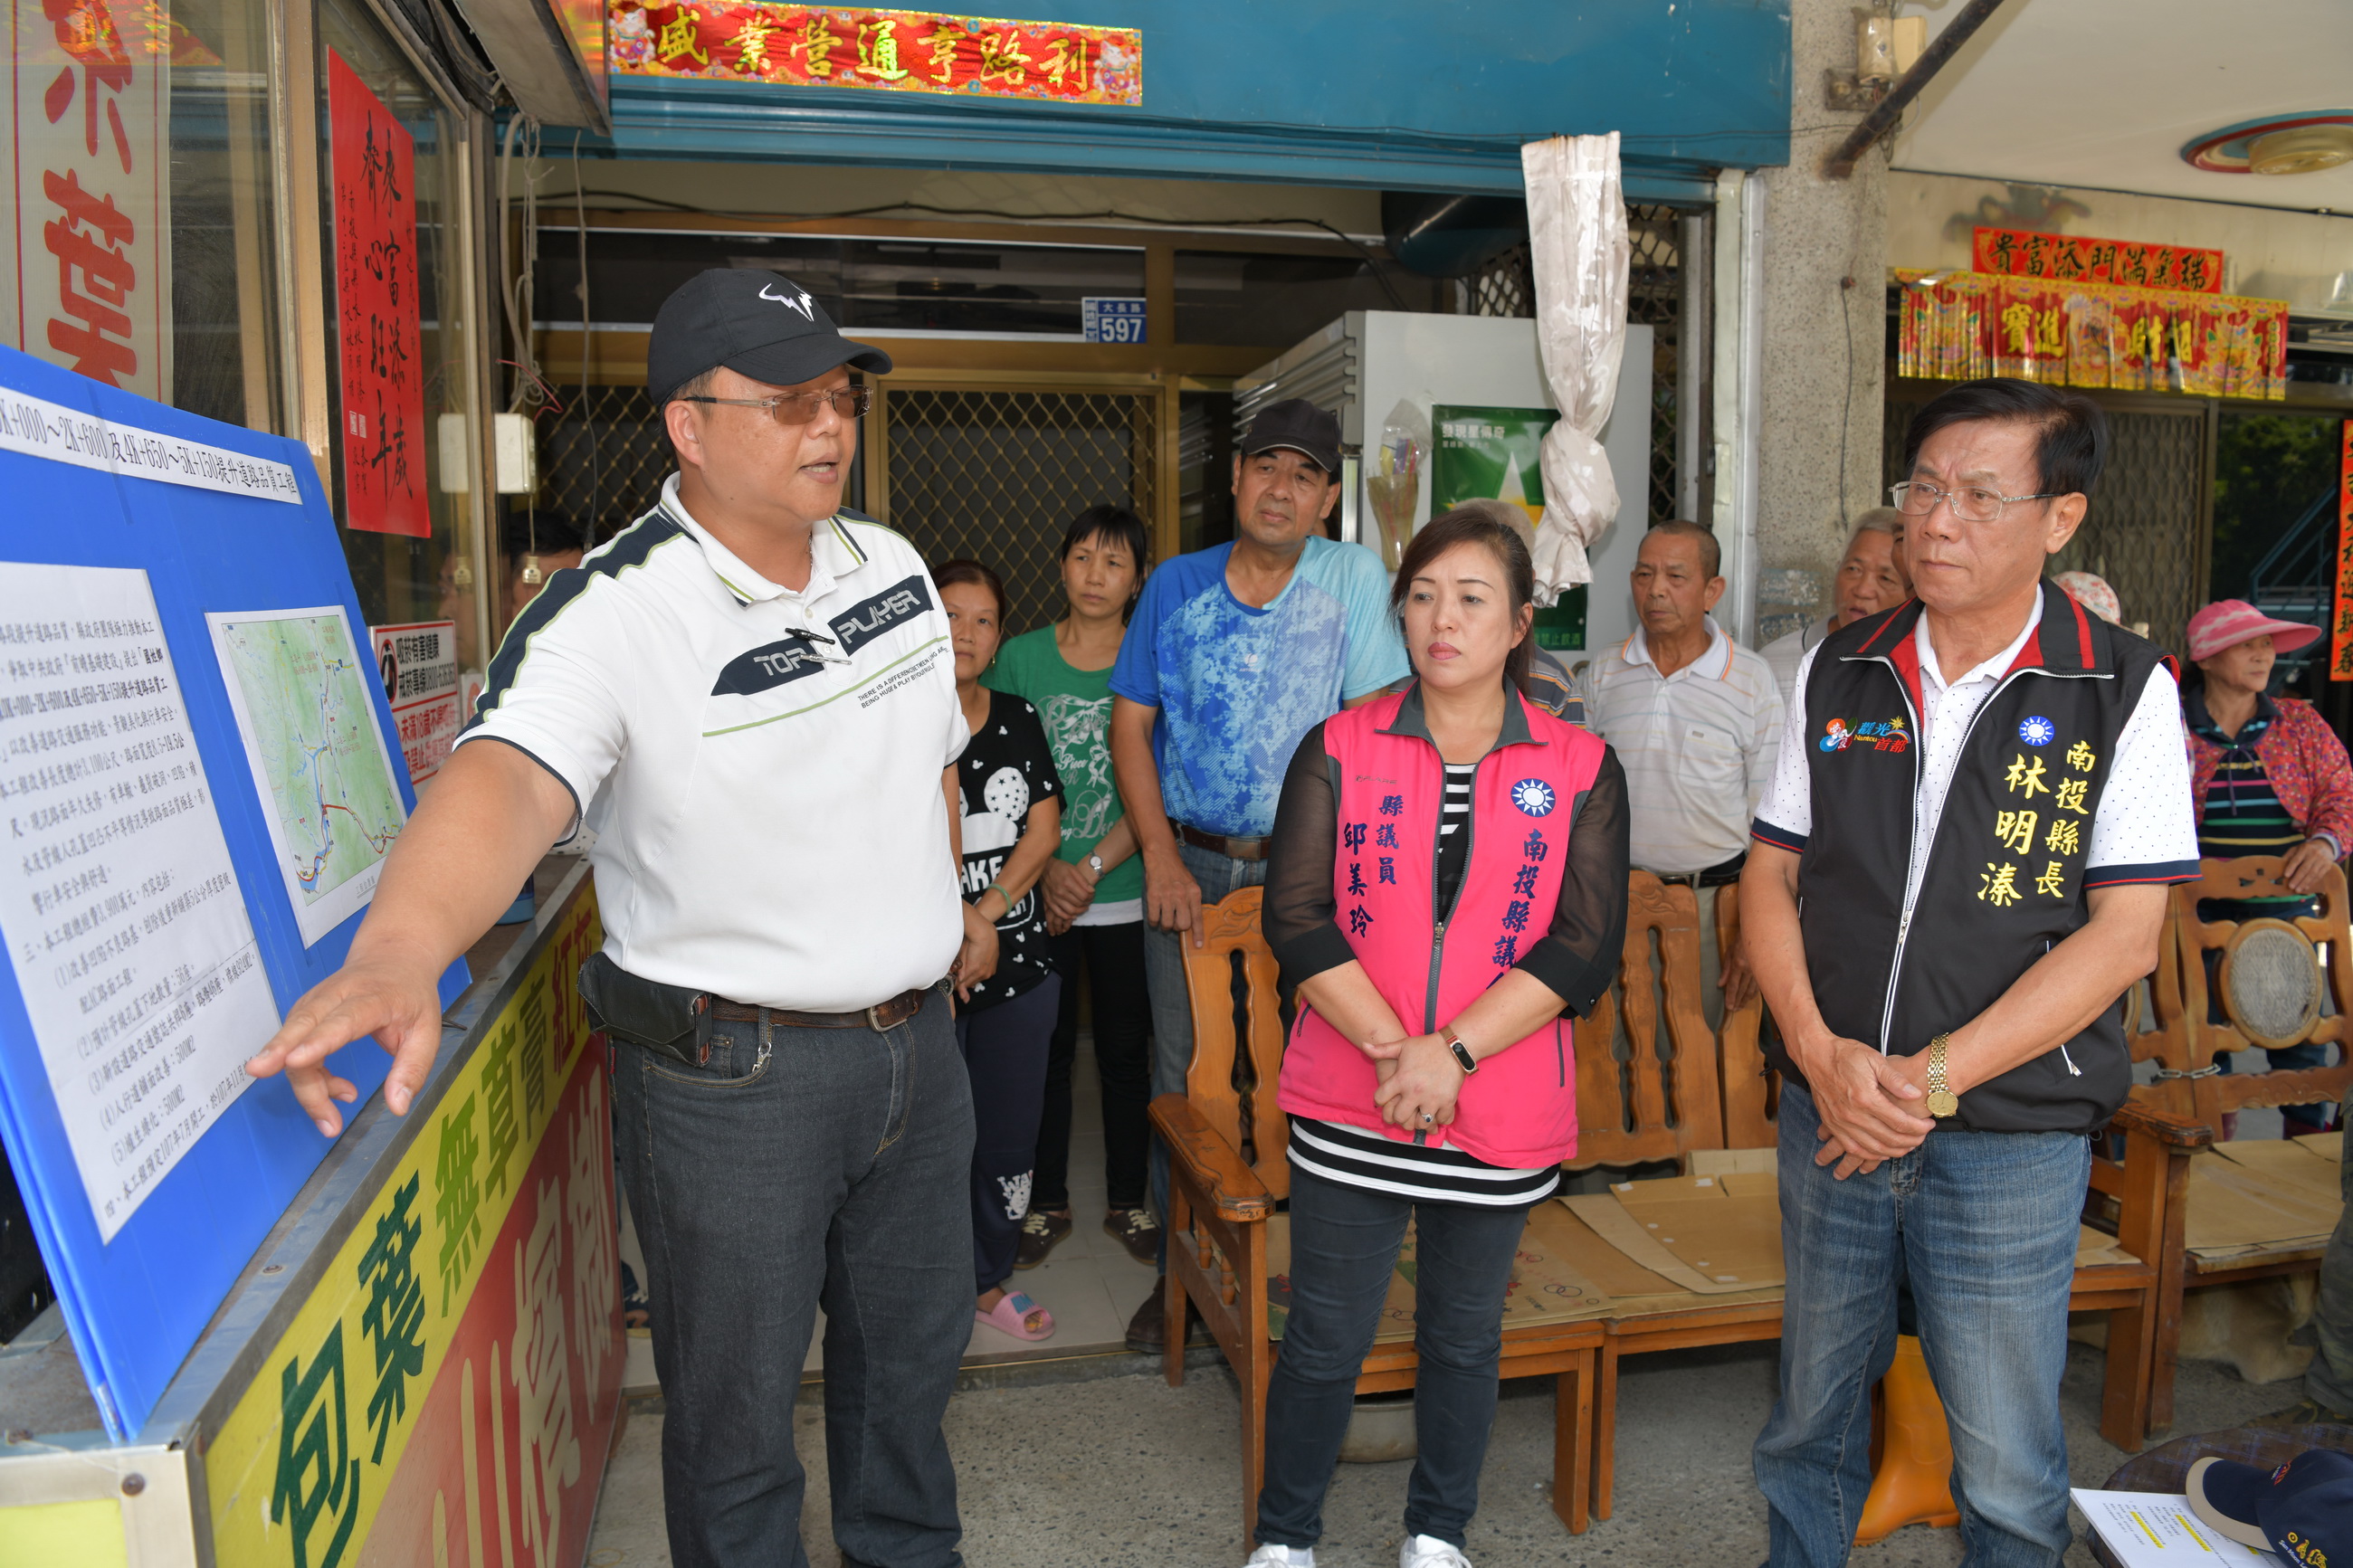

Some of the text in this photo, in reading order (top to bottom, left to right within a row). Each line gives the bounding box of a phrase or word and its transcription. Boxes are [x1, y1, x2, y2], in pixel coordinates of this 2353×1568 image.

[1101, 318, 1142, 342] 597
[754, 589, 921, 677] TOP PLAYER
[858, 689, 876, 702] THERE
[862, 697, 880, 708] BEING
[880, 687, 893, 698] HUGE
[898, 678, 910, 688] PLAY
[1853, 734, 1878, 743] Nantou
[1857, 721, 1891, 736] 觀光
[1873, 737, 1909, 754] 首都
[1376, 794, 1404, 885] 縣議員
[1977, 753, 2051, 907] 林明溱
[2035, 739, 2096, 898] 南投縣長
[1343, 822, 1374, 938] 邱美玲
[1486, 828, 1548, 991] 南投縣議
